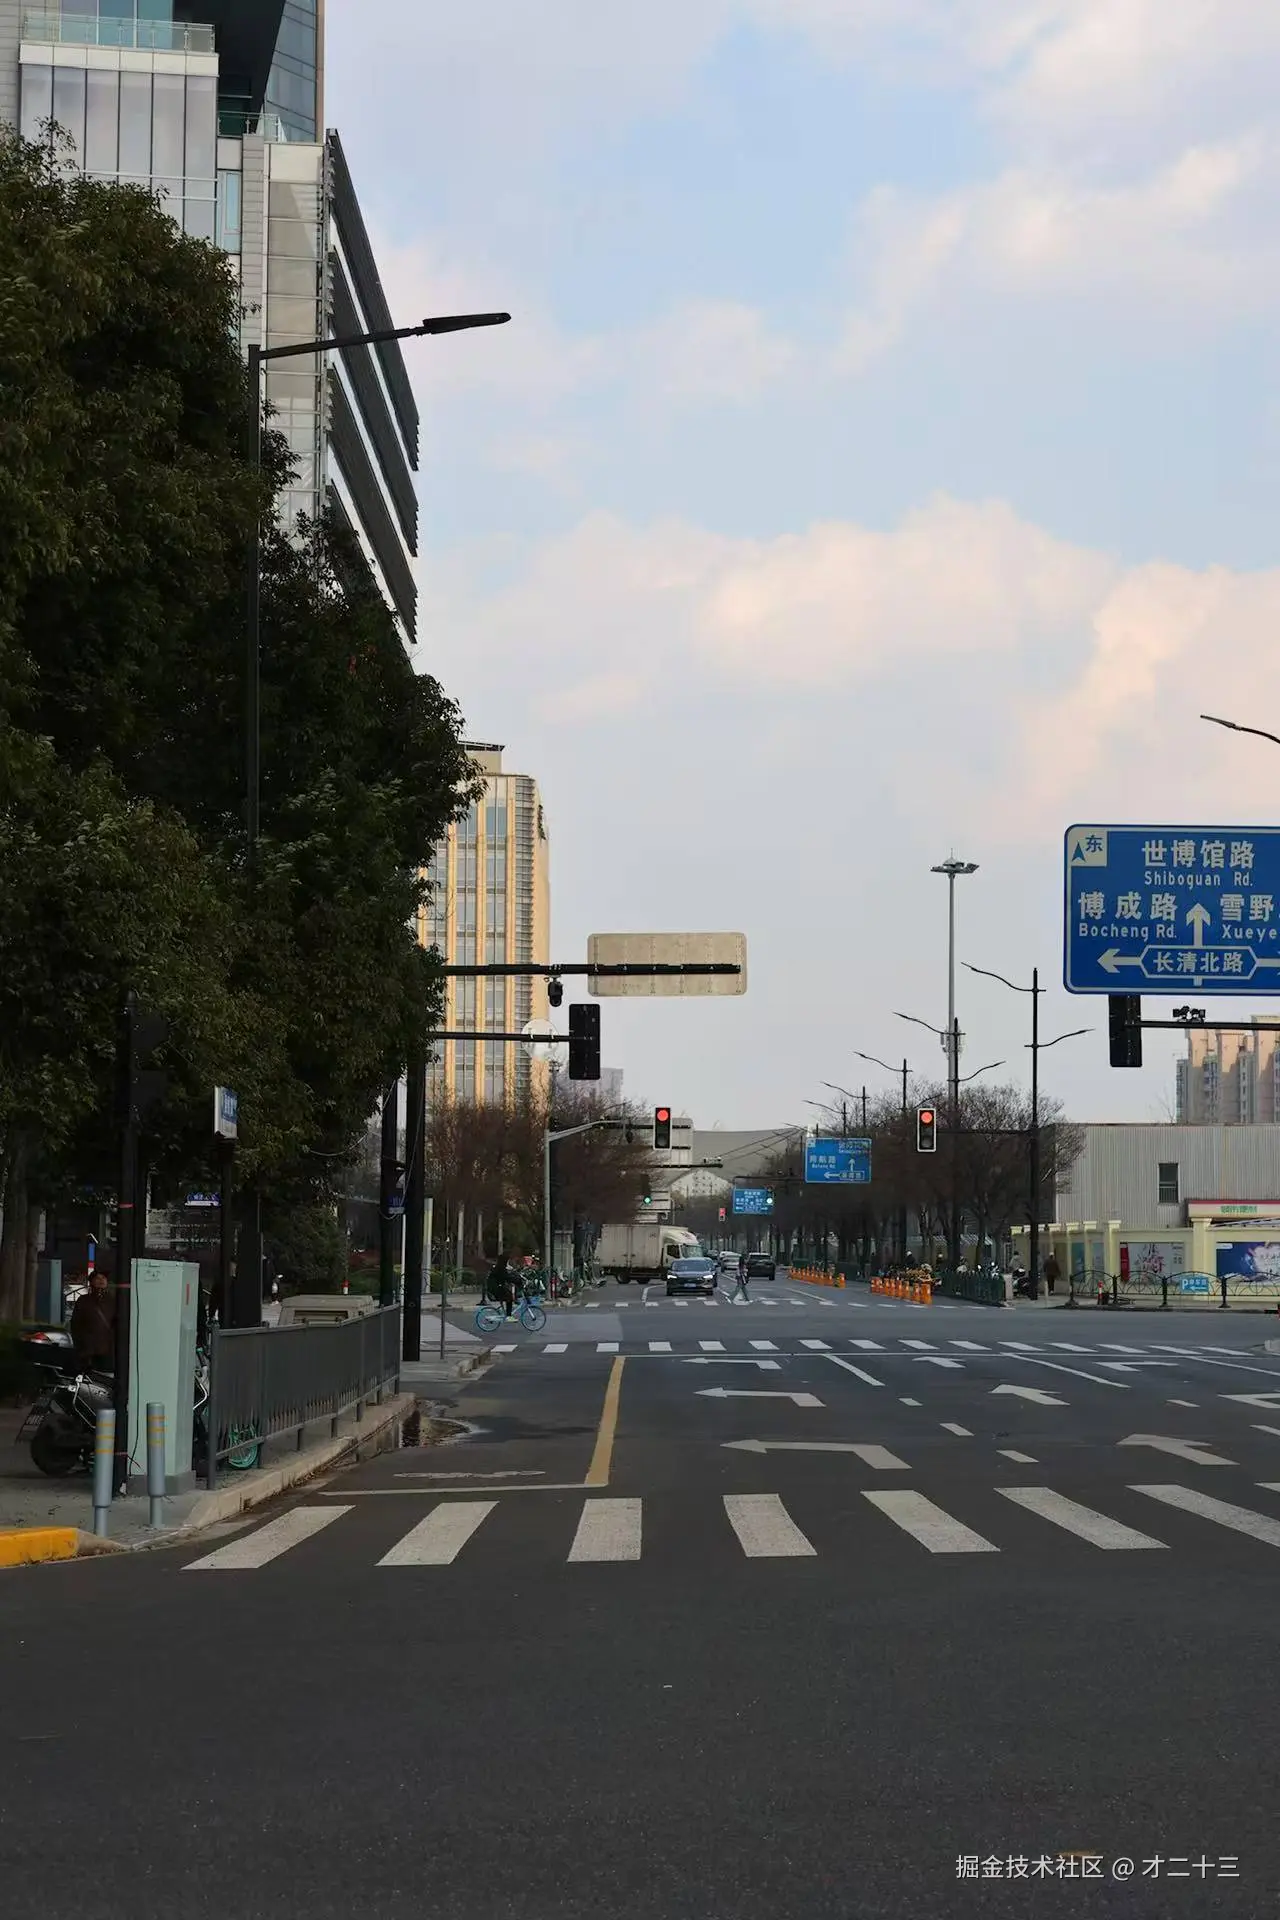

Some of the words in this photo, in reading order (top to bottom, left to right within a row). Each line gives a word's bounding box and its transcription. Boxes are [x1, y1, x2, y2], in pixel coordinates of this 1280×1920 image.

[1085, 834, 1103, 853] 东
[1141, 840, 1255, 869] 世博馆路
[1144, 871, 1221, 889] Shiboguan
[1234, 872, 1253, 887] Rd.
[1078, 891, 1178, 920] 博成路
[1219, 893, 1280, 922] 雪野
[1078, 923, 1149, 941] Bocheng
[1156, 924, 1177, 939] Rd.
[1222, 924, 1278, 942] Xueye
[1152, 951, 1244, 973] 长清北路
